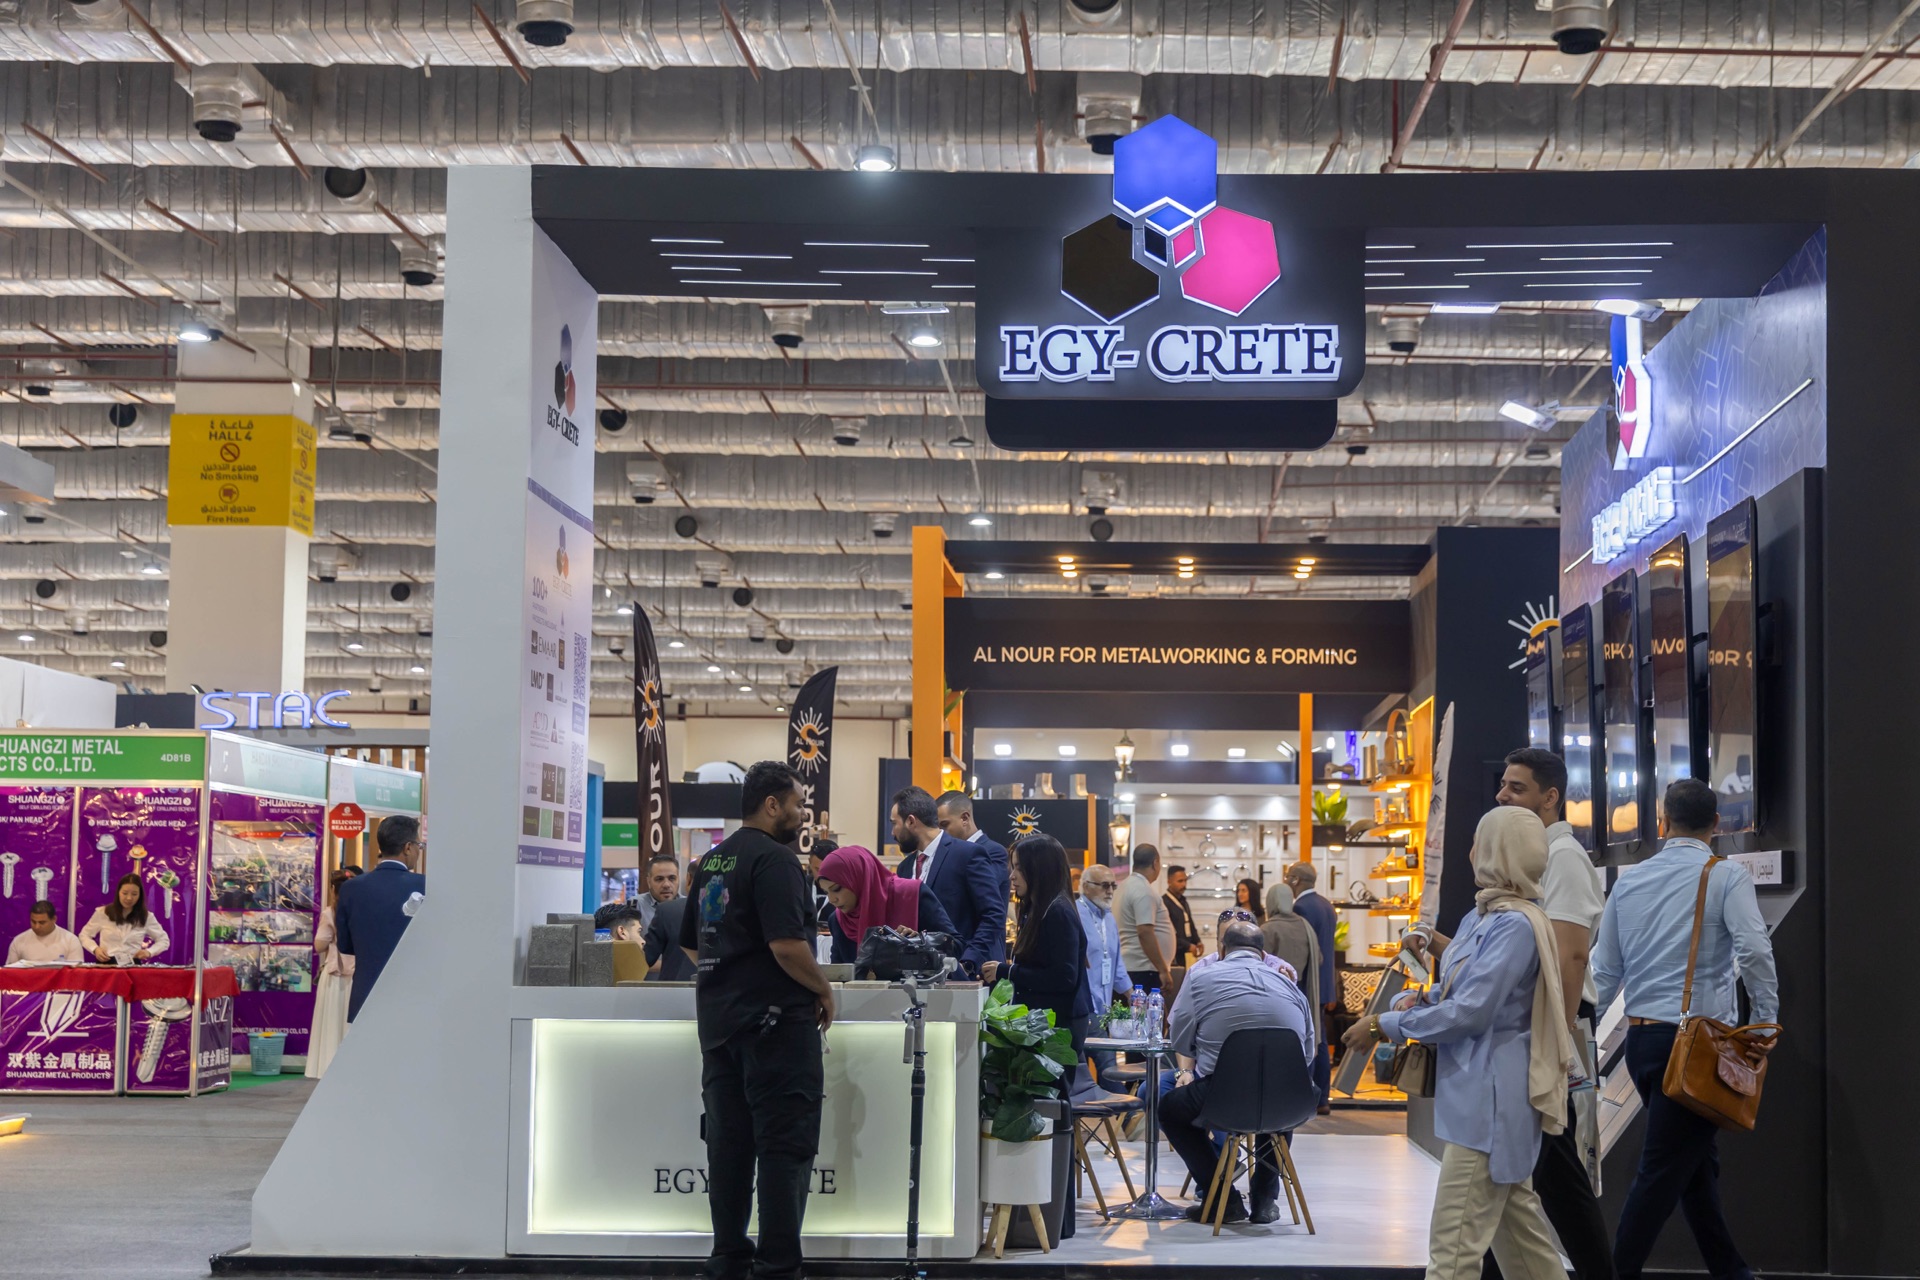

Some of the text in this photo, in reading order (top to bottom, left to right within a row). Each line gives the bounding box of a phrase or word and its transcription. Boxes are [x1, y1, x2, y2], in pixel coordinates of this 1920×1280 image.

[1001, 326, 1339, 380] EGY- CRETE
[220, 420, 254, 430] قاعة
[547, 405, 579, 446] EGY- CRETE
[209, 431, 252, 441] HALL 4
[201, 472, 259, 482] No Smoking
[207, 515, 224, 523] Fire
[532, 575, 548, 601] 100+
[973, 646, 1358, 665] AL NOUR FOR METALWORKING & FORMING
[200, 690, 351, 729] STAC
[72, 739, 123, 754] METAL
[161, 753, 191, 762] 4D81B
[32, 757, 96, 775] CO.,LTD.
[8, 795, 55, 804] SHUANGZI
[134, 797, 182, 805] SHUANGZI
[649, 759, 664, 861] OUR
[25, 816, 43, 824] HEAD
[7, 1052, 112, 1069] 双紫金属制品
[6, 1071, 45, 1079] SHUANGZI
[46, 1071, 71, 1079] METAL
